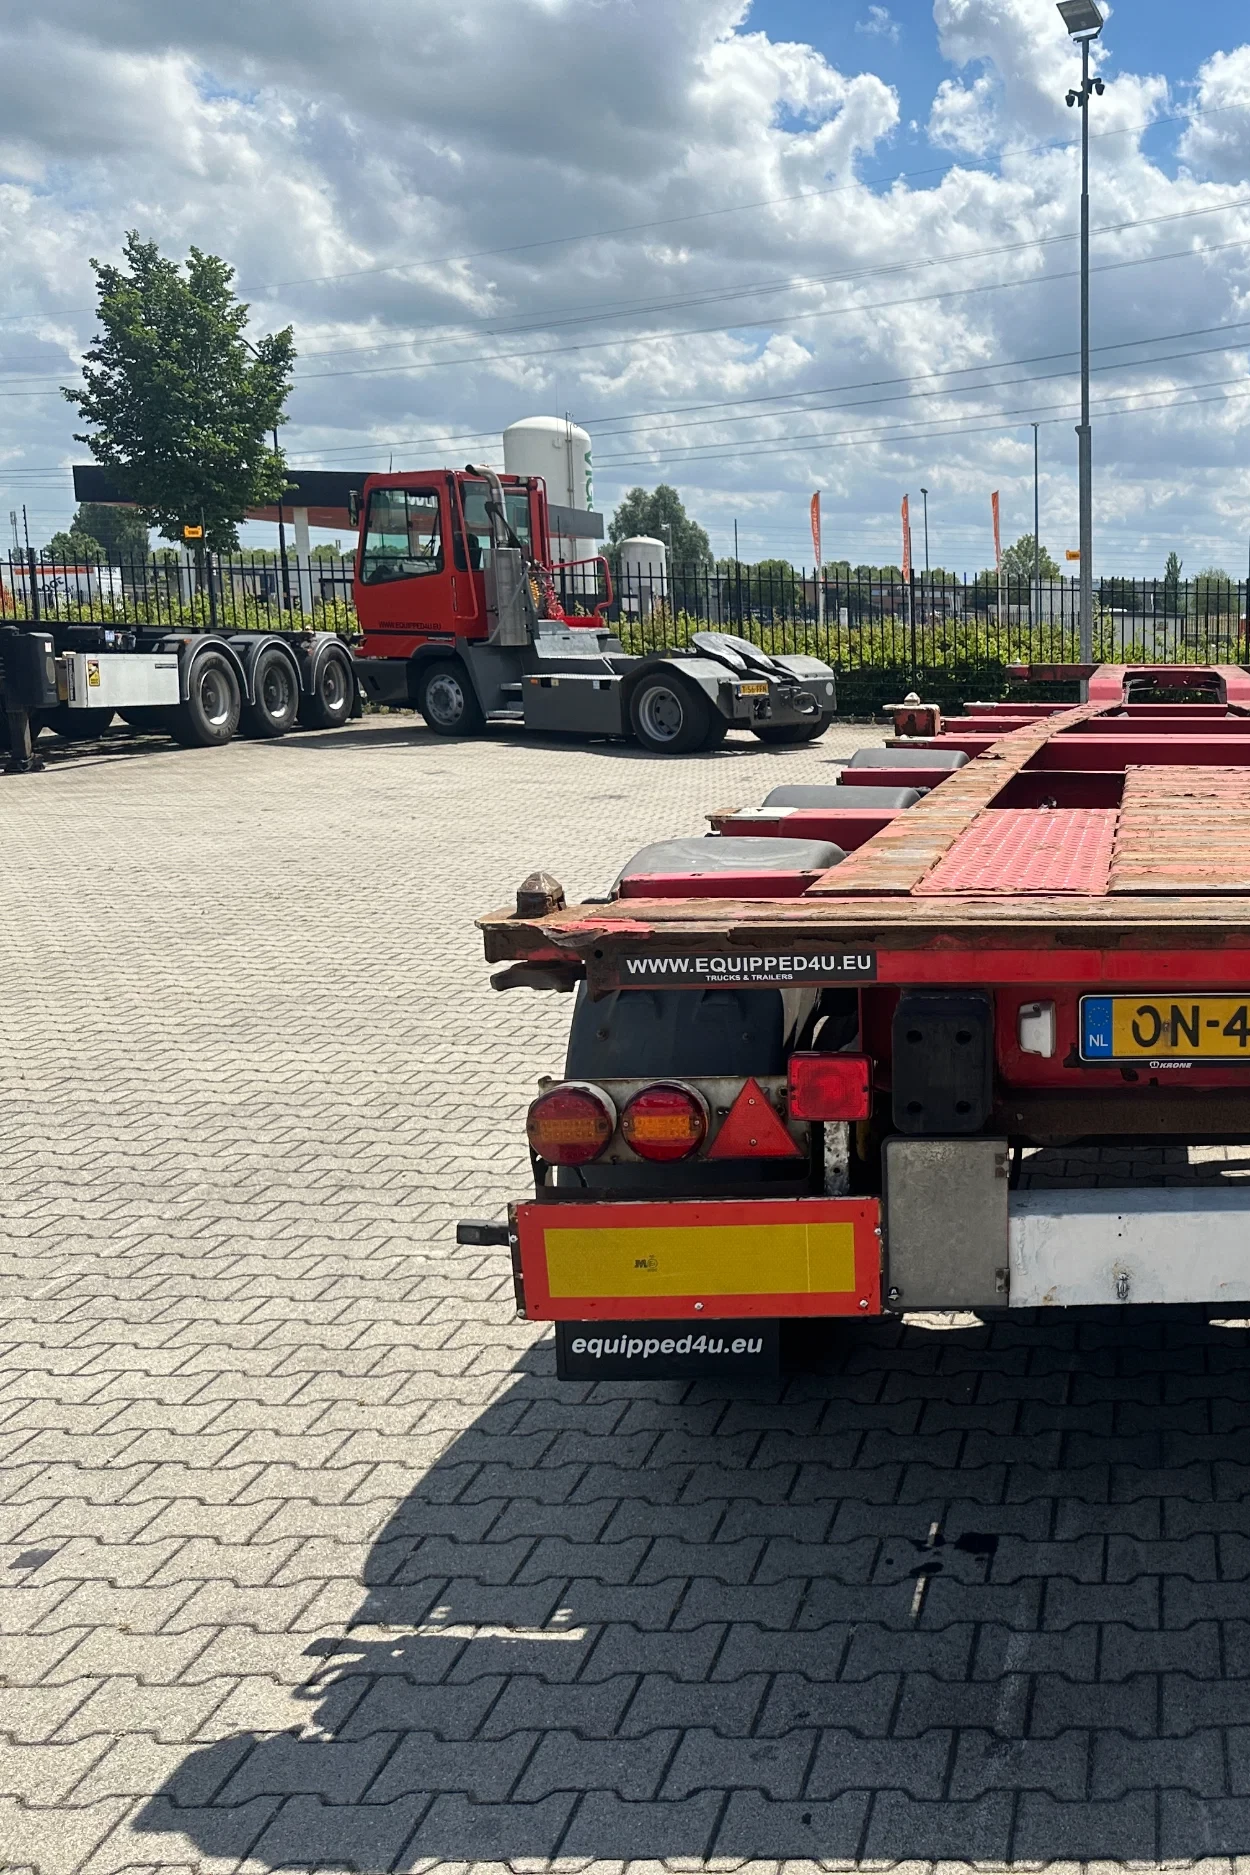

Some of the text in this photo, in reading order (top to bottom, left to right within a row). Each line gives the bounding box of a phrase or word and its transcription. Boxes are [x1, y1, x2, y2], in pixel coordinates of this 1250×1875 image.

[626, 955, 871, 974] WWW.EQUIPPED4U.EU
[751, 973, 793, 981] TRAILERS
[1089, 1034, 1109, 1047] NL
[571, 1334, 763, 1359] equipped4u.eu
